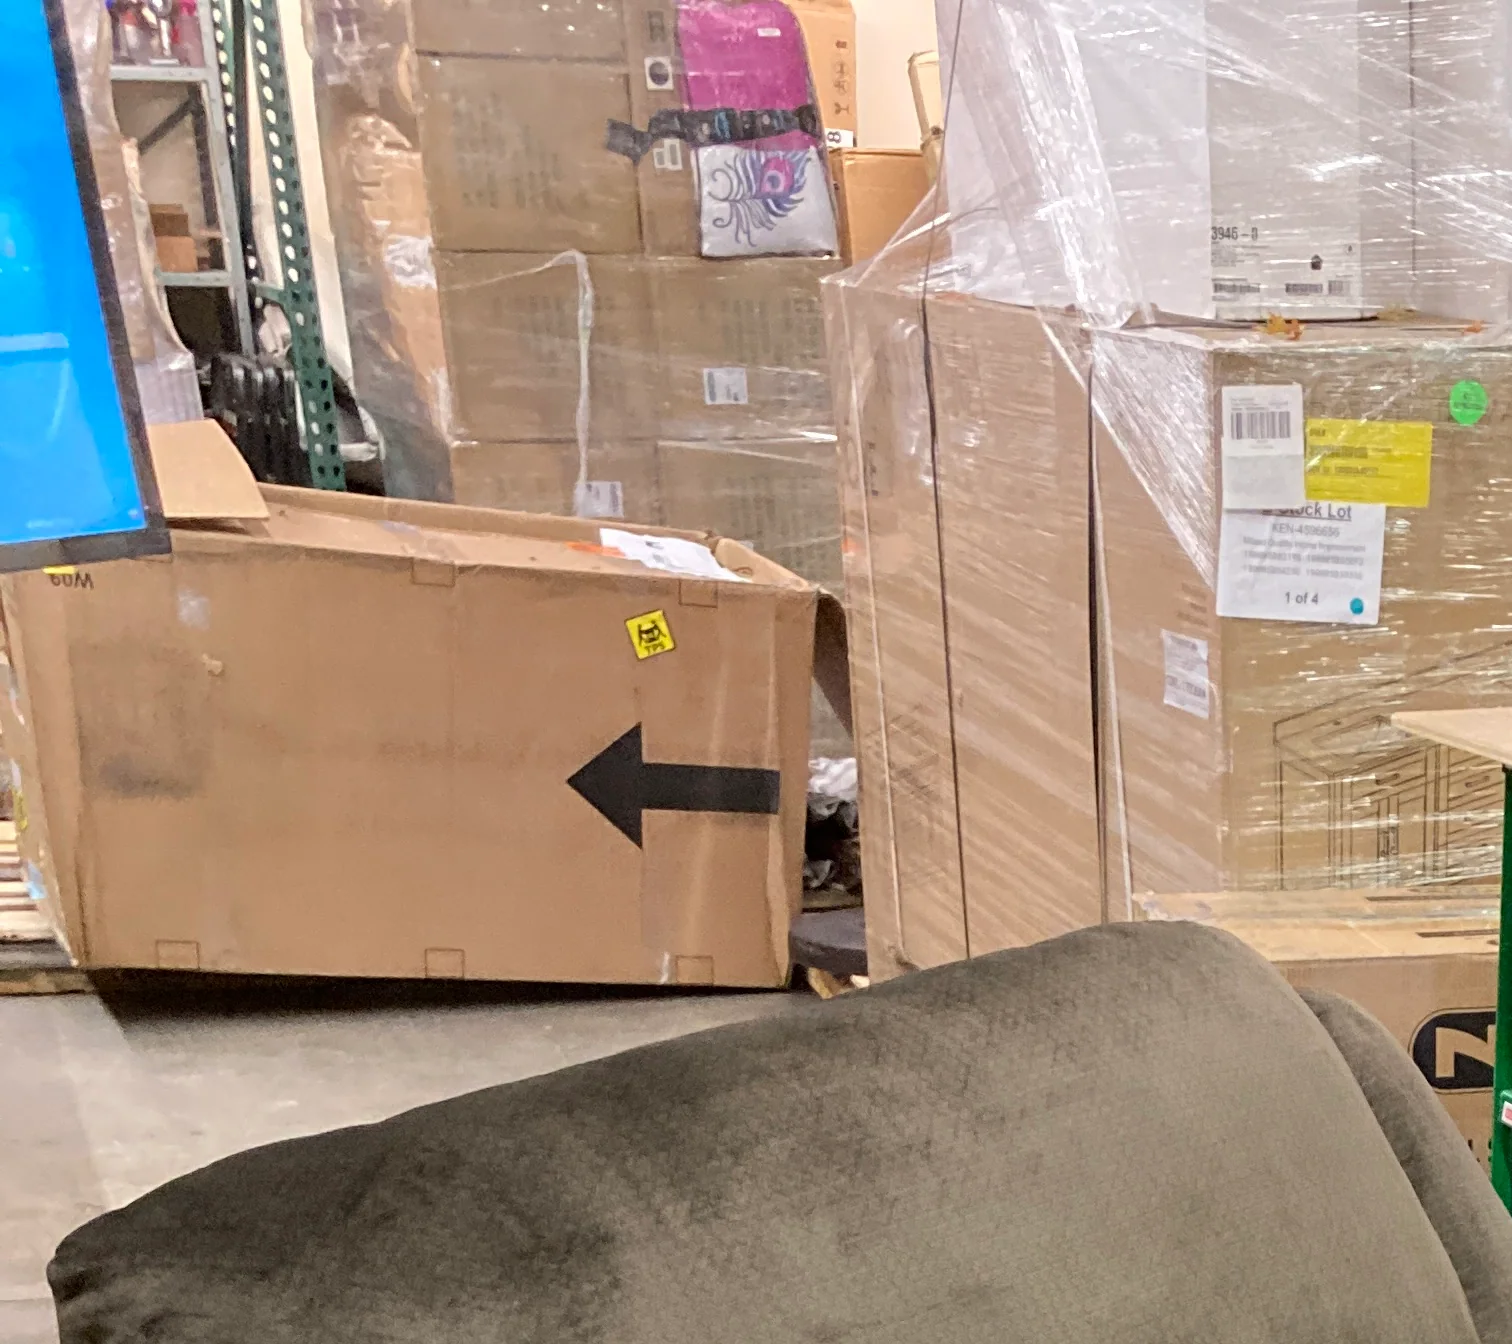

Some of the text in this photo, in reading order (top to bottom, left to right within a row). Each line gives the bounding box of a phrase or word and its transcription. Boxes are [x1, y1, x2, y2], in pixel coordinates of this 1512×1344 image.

[1327, 503, 1352, 519] Lot
[1285, 591, 1319, 605] 1 of 4
